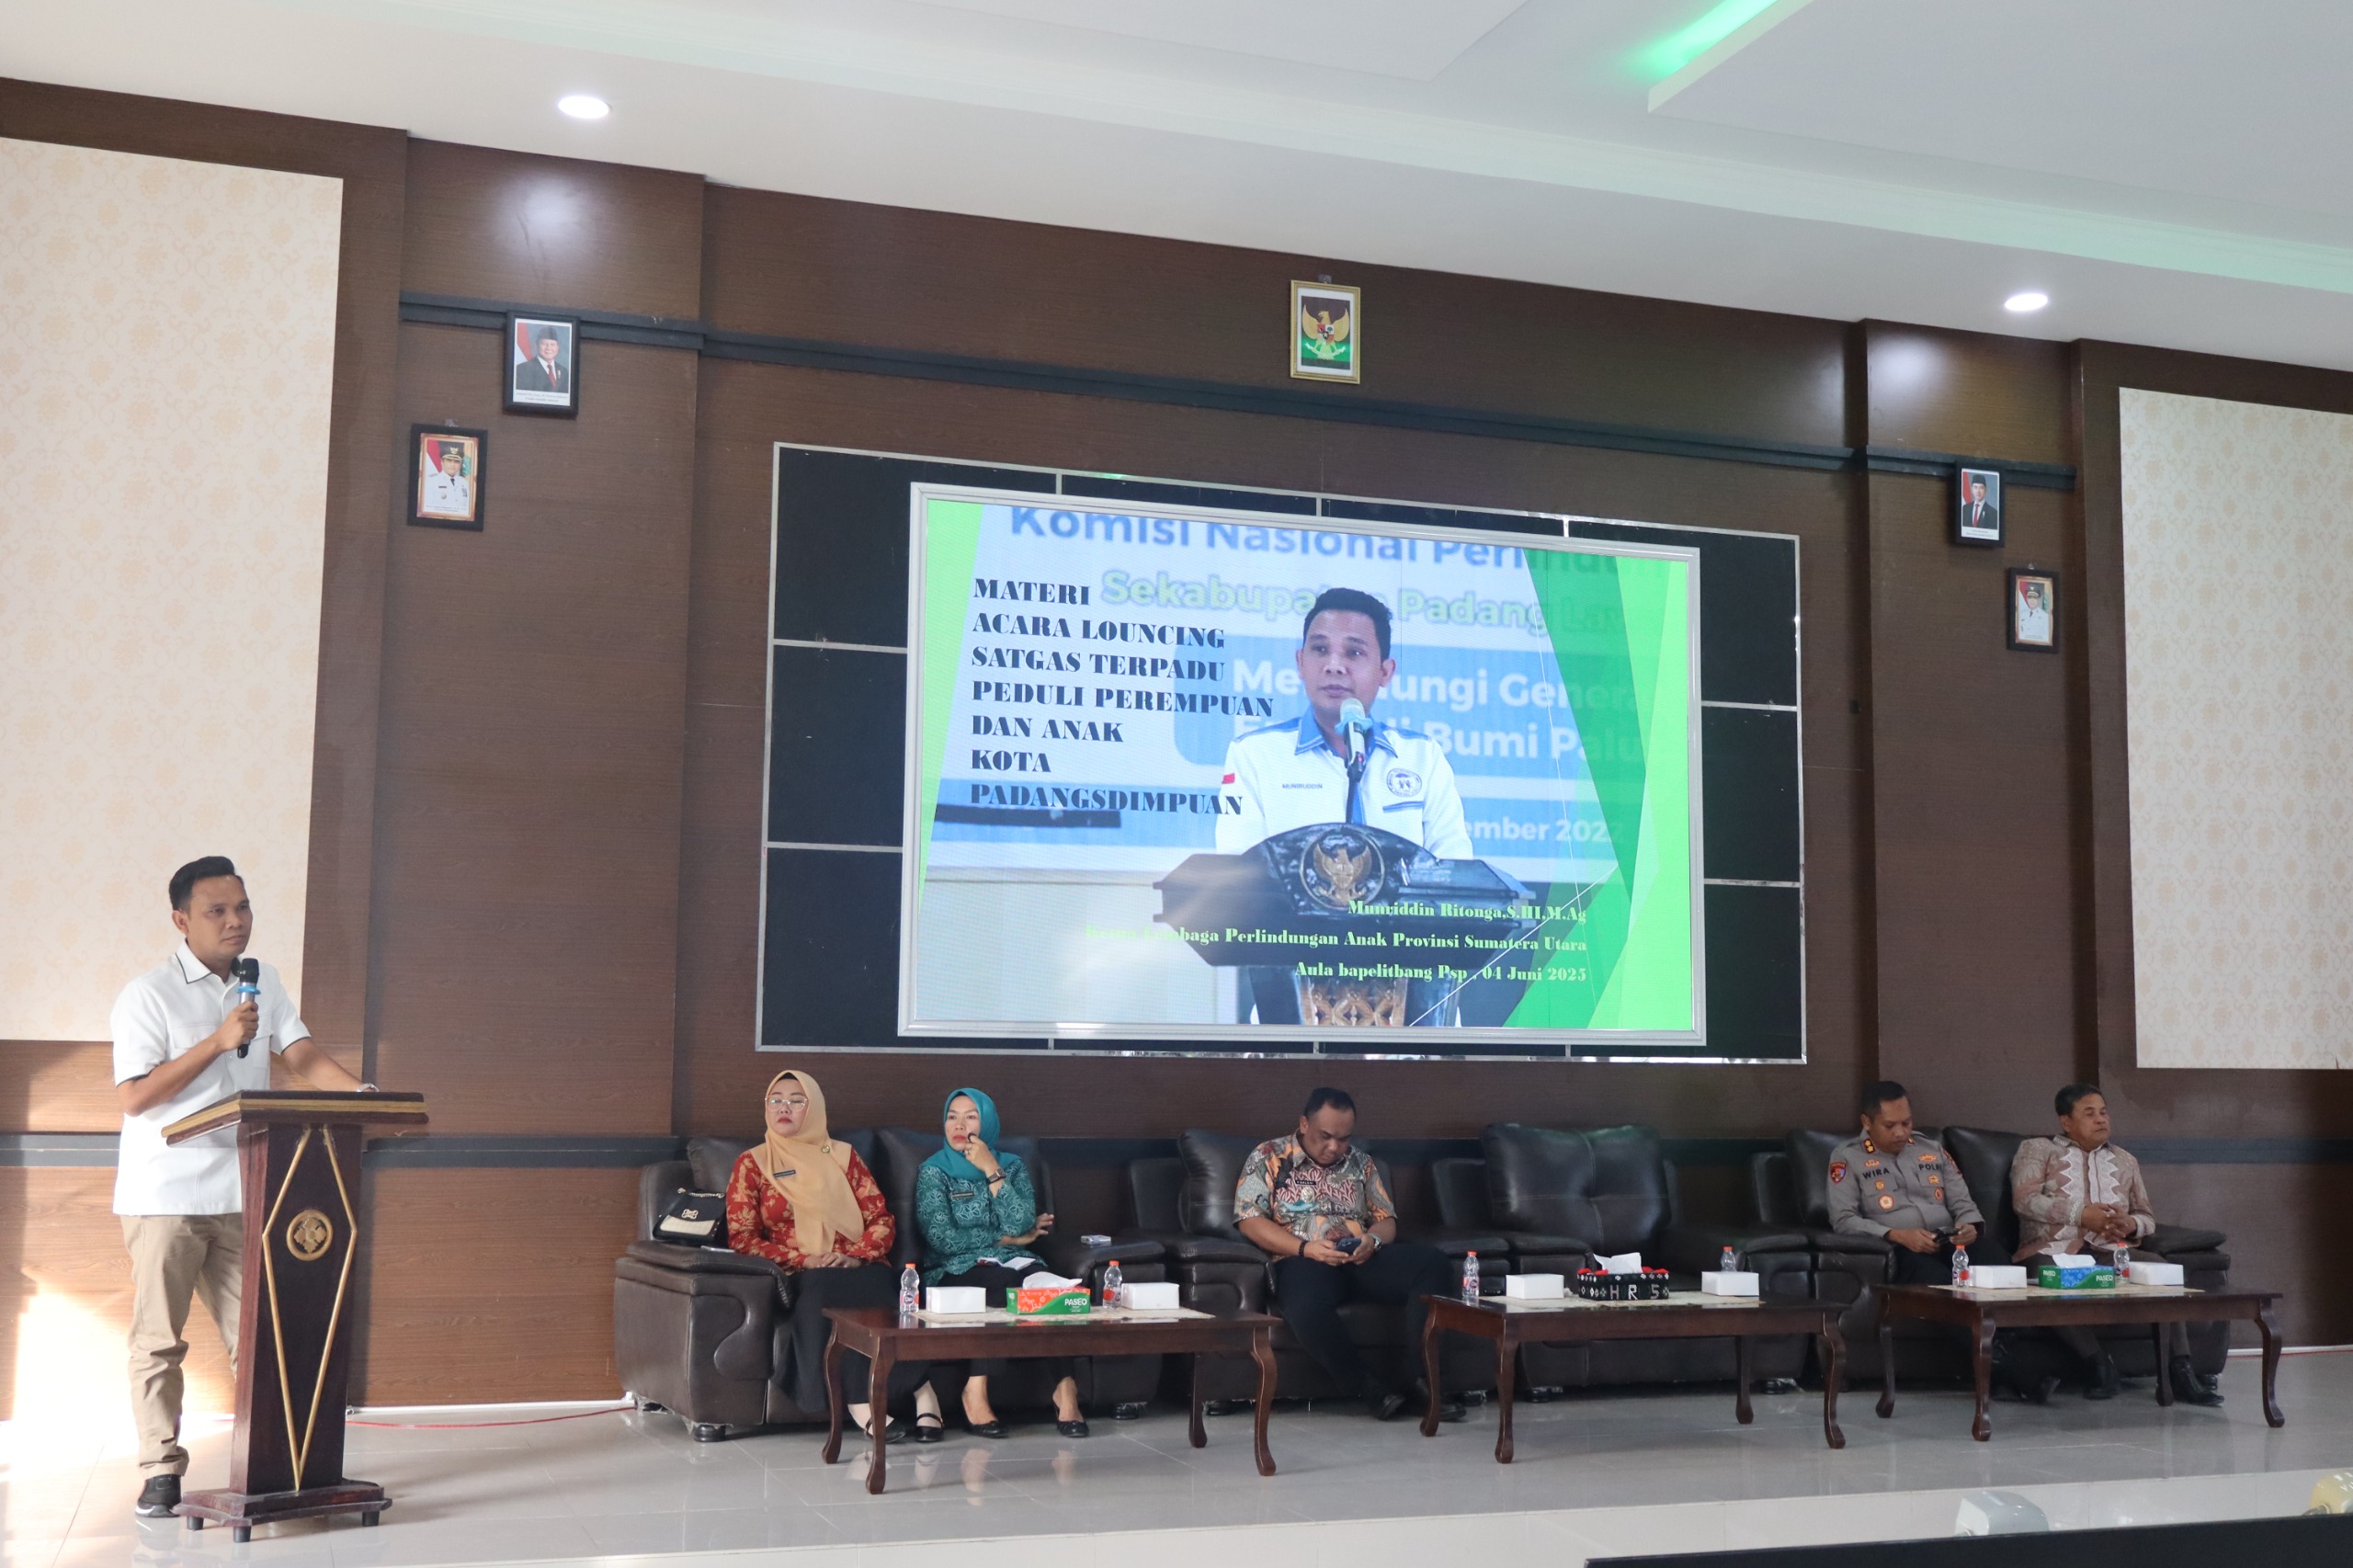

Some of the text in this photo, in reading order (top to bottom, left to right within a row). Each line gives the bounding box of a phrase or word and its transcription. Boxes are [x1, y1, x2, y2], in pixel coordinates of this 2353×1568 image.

[973, 577, 1091, 606] MATERI
[1397, 588, 1550, 636] Padang
[972, 612, 1225, 649] ACARA LOUNCING
[972, 646, 1225, 681] SATGAS TERPADU
[972, 680, 1274, 718] PEDULI PEREMPUAN
[972, 715, 1124, 743] DAN ANAK
[971, 749, 1051, 773] KOTA
[971, 784, 1244, 815] PADANGSDIMPUAN
[1225, 927, 1339, 949] Perlindungan
[1344, 931, 1388, 947] Anak
[1392, 932, 1460, 948] Provinsi
[1464, 934, 1540, 950] Sumatera
[1544, 937, 1586, 951] Utara
[1295, 961, 1334, 977] Aula
[1338, 962, 1433, 983] bapelitbang
[1438, 964, 1468, 983] Psp
[1482, 966, 1502, 980] 04
[1507, 966, 1542, 981] Juni
[1547, 967, 1587, 982] 2025
[1862, 1167, 1891, 1180] WIRA
[1918, 1163, 1942, 1171] POLRI
[1064, 1298, 1087, 1306] PASEO
